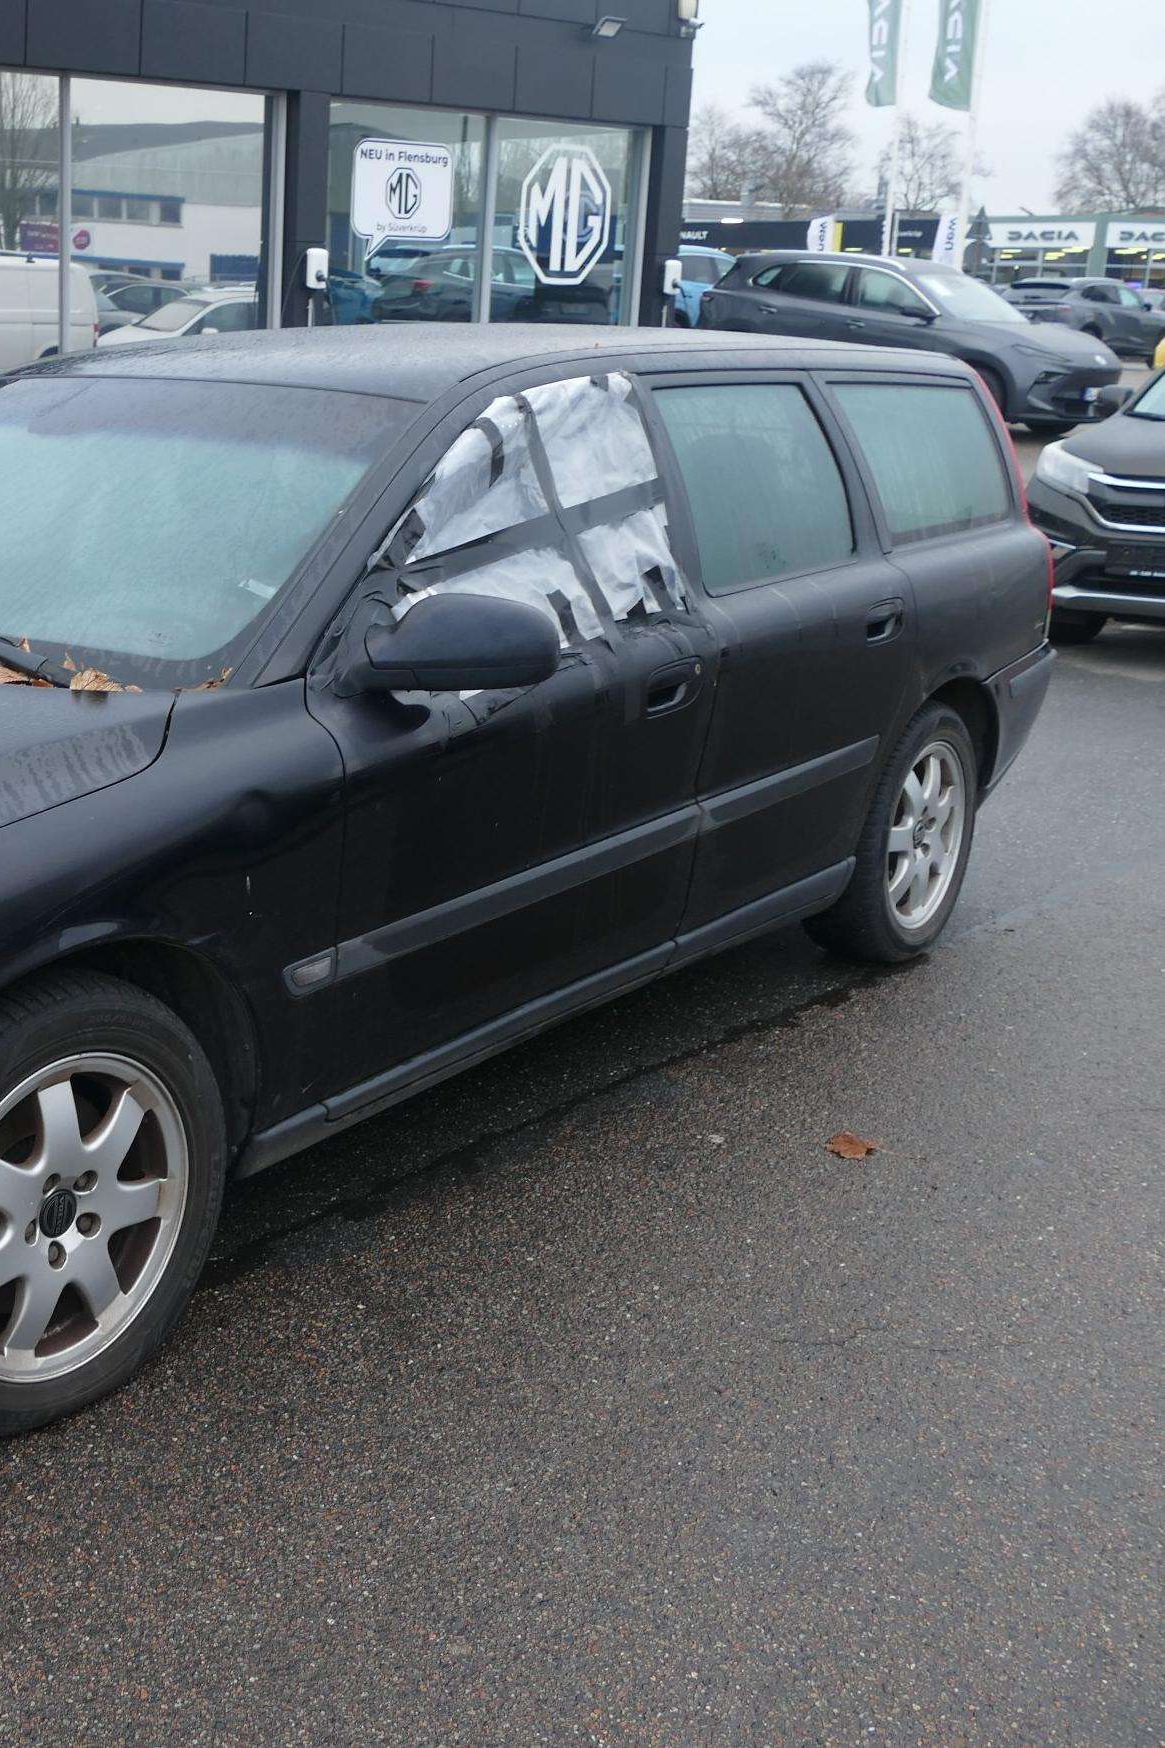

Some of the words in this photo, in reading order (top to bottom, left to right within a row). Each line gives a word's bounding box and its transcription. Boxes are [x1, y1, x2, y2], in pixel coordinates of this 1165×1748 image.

[360, 148, 383, 160] NEU
[385, 149, 395, 160] in
[398, 151, 449, 167] Flensburg
[389, 172, 418, 214] MG
[528, 156, 604, 272] MG
[1008, 230, 1079, 241] DACIA
